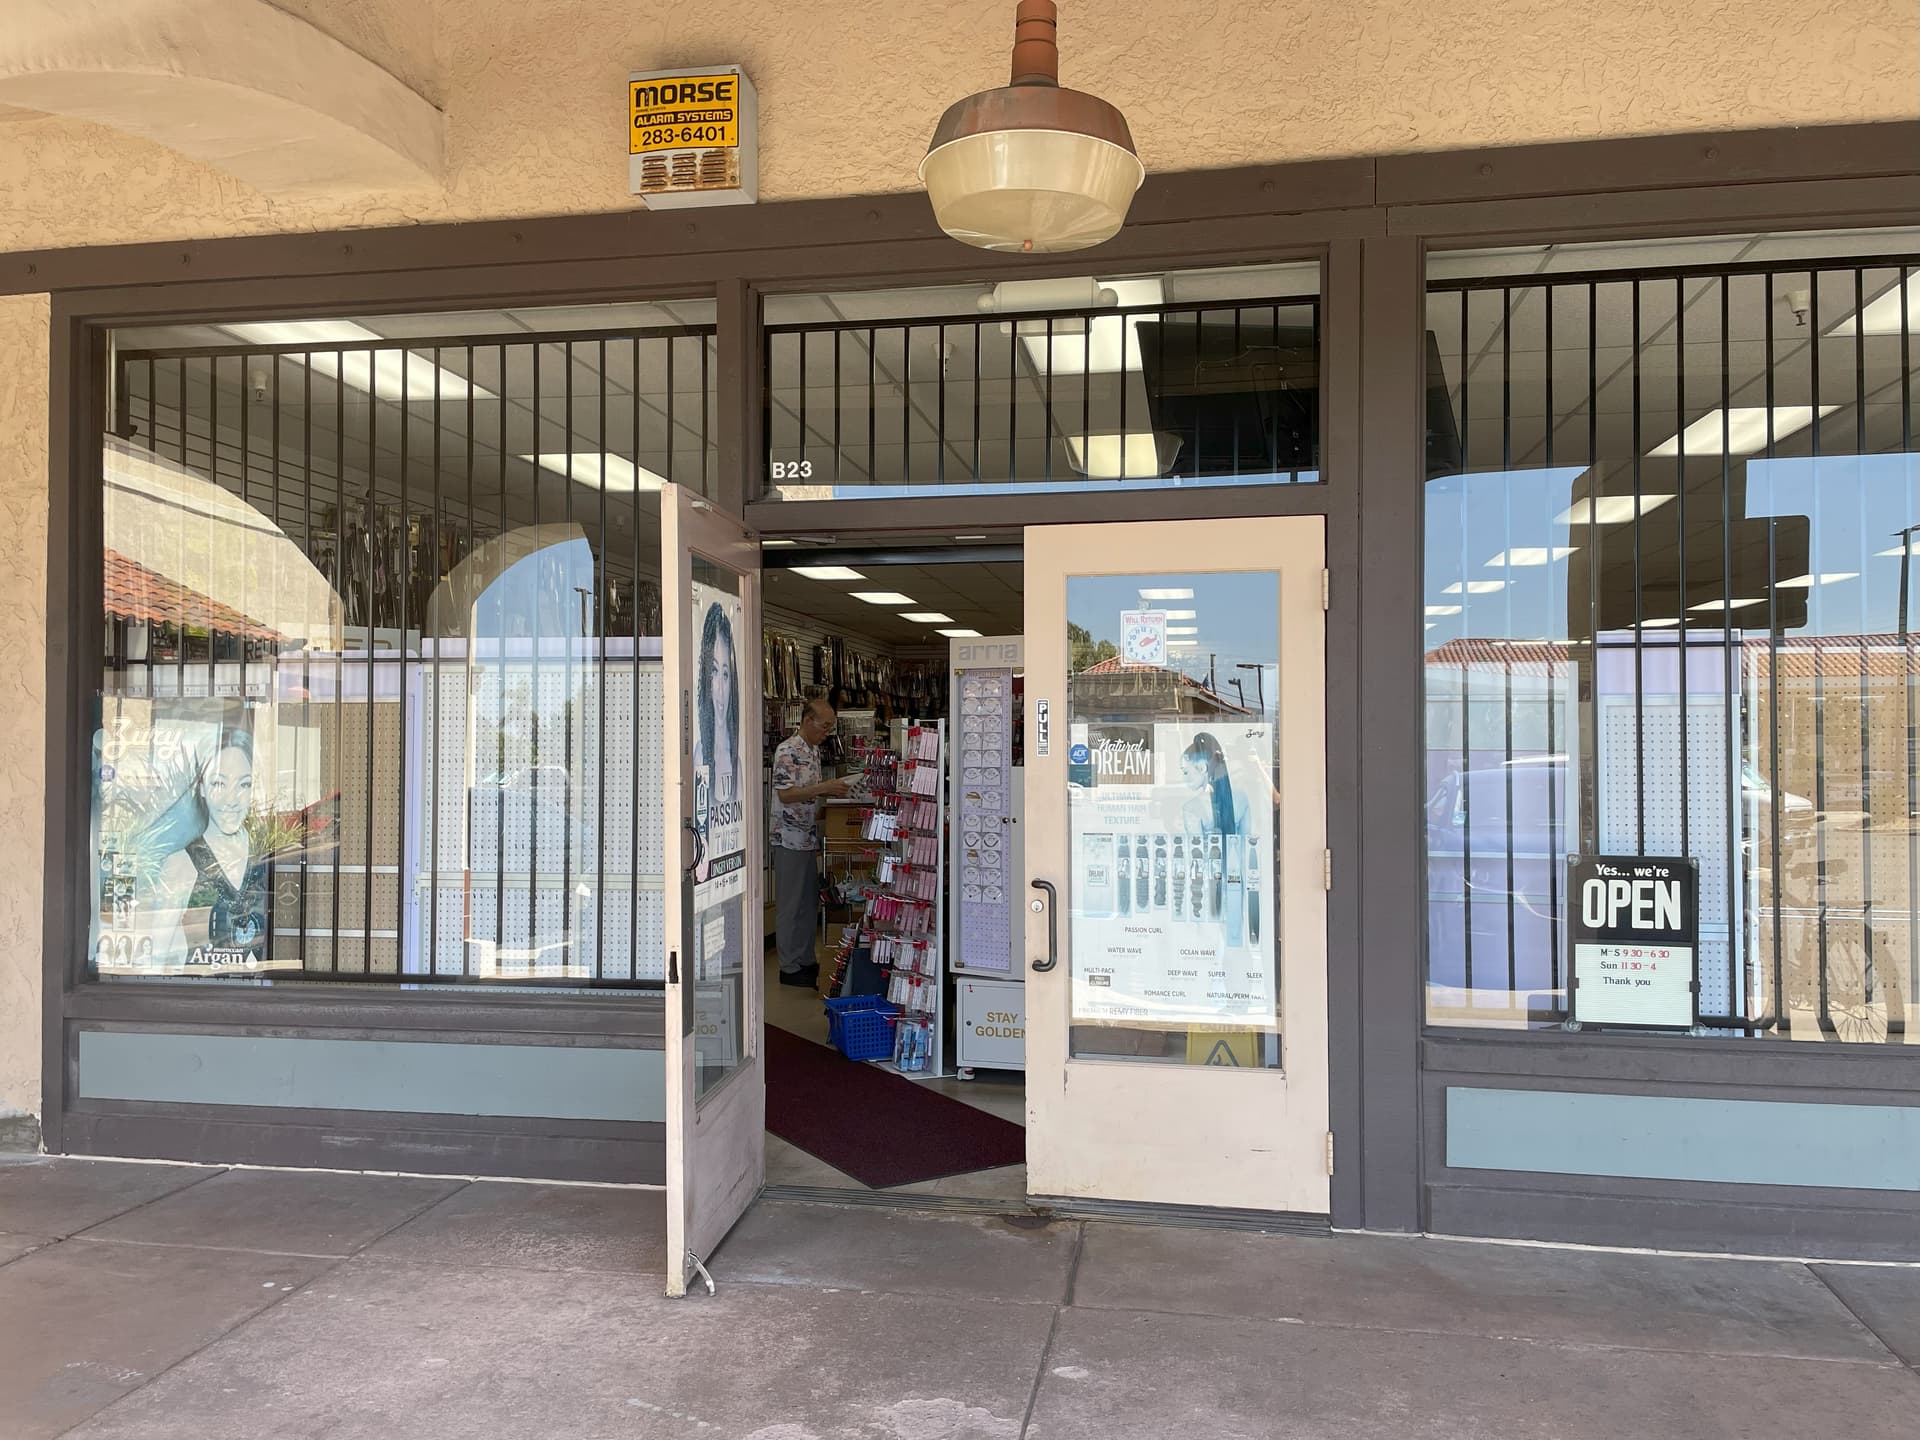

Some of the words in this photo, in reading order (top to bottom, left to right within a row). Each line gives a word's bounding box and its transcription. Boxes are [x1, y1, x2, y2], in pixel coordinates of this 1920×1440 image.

[635, 81, 734, 108] MORSE
[636, 114, 674, 127] ALARM
[677, 110, 731, 122] SYSTEMS
[642, 126, 725, 146] 283-6401
[772, 461, 812, 478] B23
[959, 644, 1018, 660] arria
[1038, 703, 1048, 742] PULL
[1097, 738, 1145, 752] Natural
[710, 800, 743, 829] PASSION
[1595, 863, 1630, 876] Yes...
[1634, 865, 1670, 878] we're
[1582, 878, 1682, 930] OPEN
[1124, 926, 1148, 934] PASSION
[1107, 946, 1126, 954] WATER
[1180, 948, 1199, 956] OCEAN
[190, 947, 244, 970] Argan
[1600, 960, 1618, 970] Sun
[1602, 976, 1631, 986] Thank
[1634, 980, 1651, 988] you
[1171, 990, 1186, 998] CURL
[986, 1012, 1018, 1024] STAY
